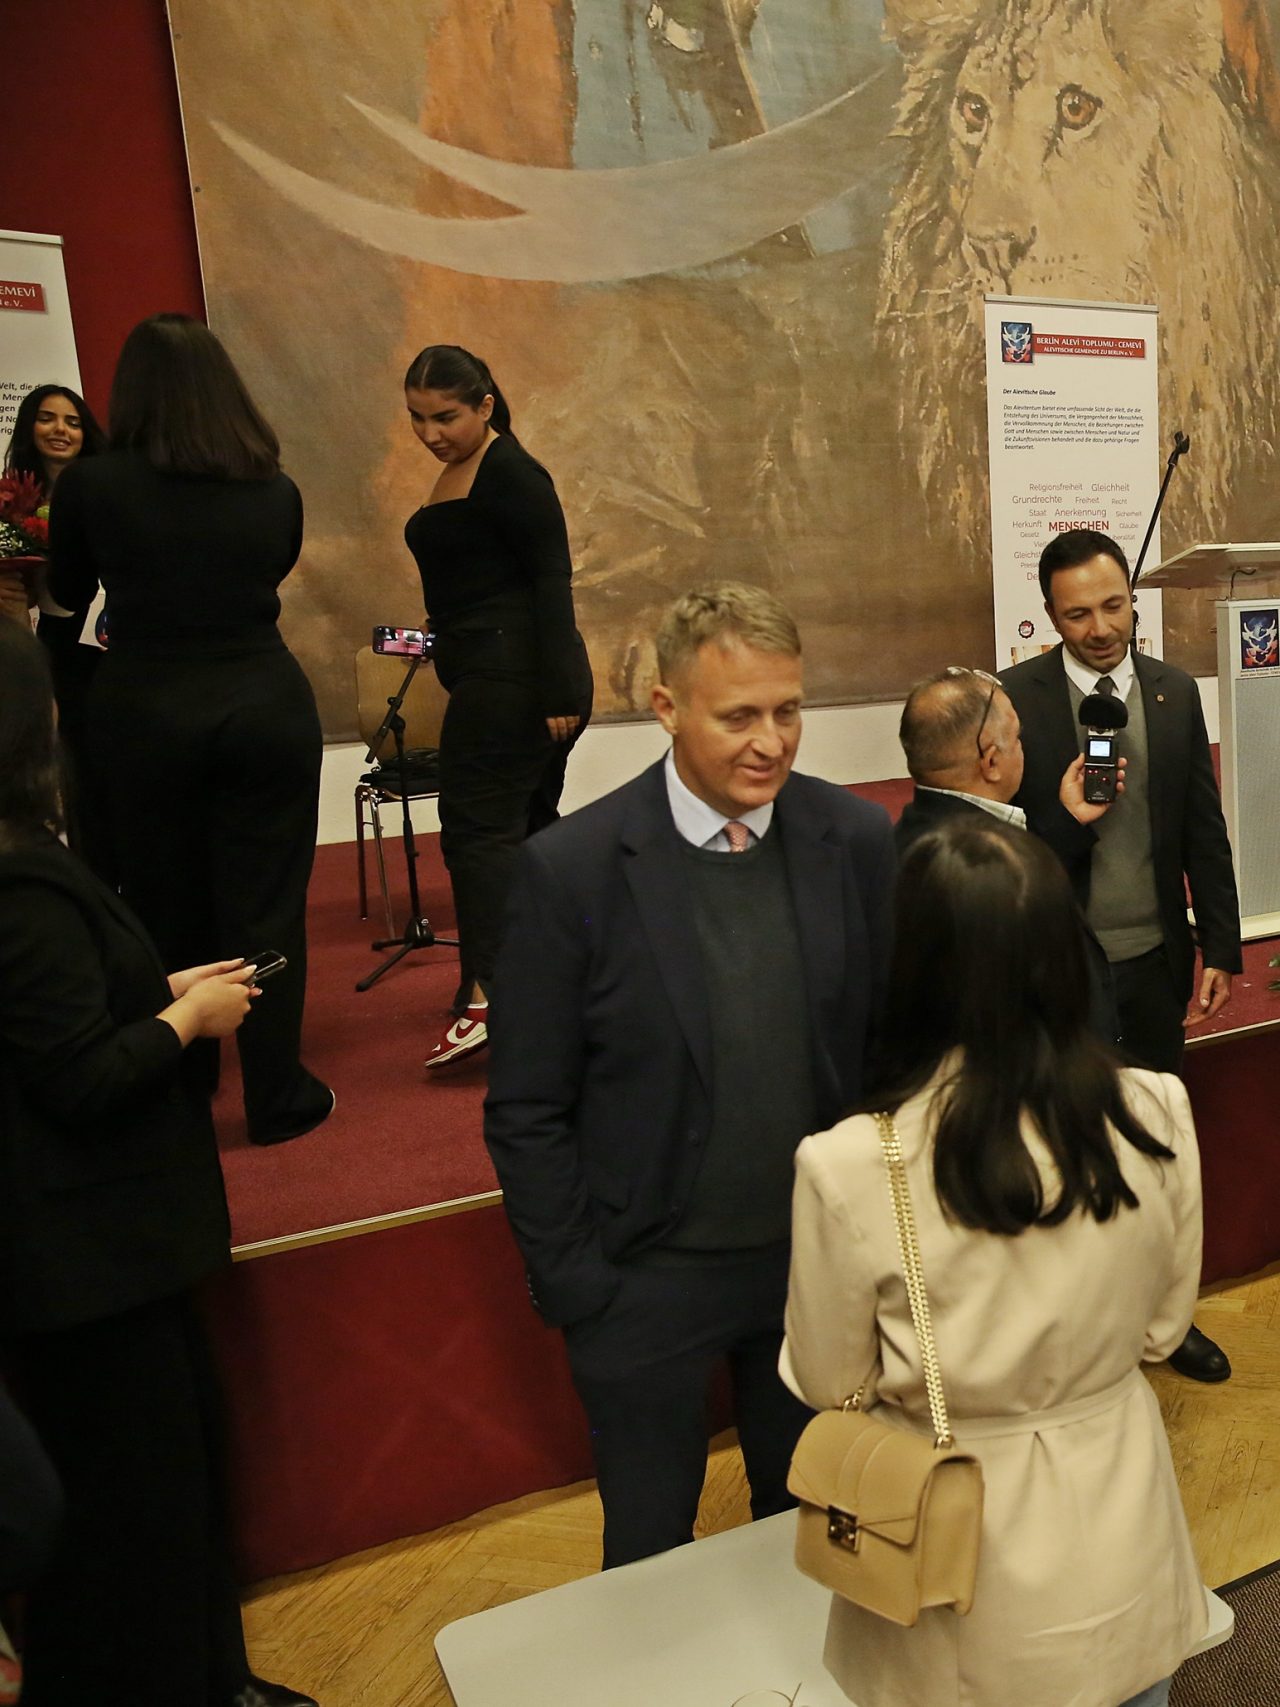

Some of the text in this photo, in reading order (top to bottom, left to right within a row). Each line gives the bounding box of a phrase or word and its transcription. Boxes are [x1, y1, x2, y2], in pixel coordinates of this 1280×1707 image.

[1030, 483, 1130, 492] Religionsfreiheit Gleichheit
[1012, 496, 1062, 504] Grundrechte
[1055, 509, 1107, 518] Anerkennung
[1048, 521, 1109, 532] MENSCHEN
